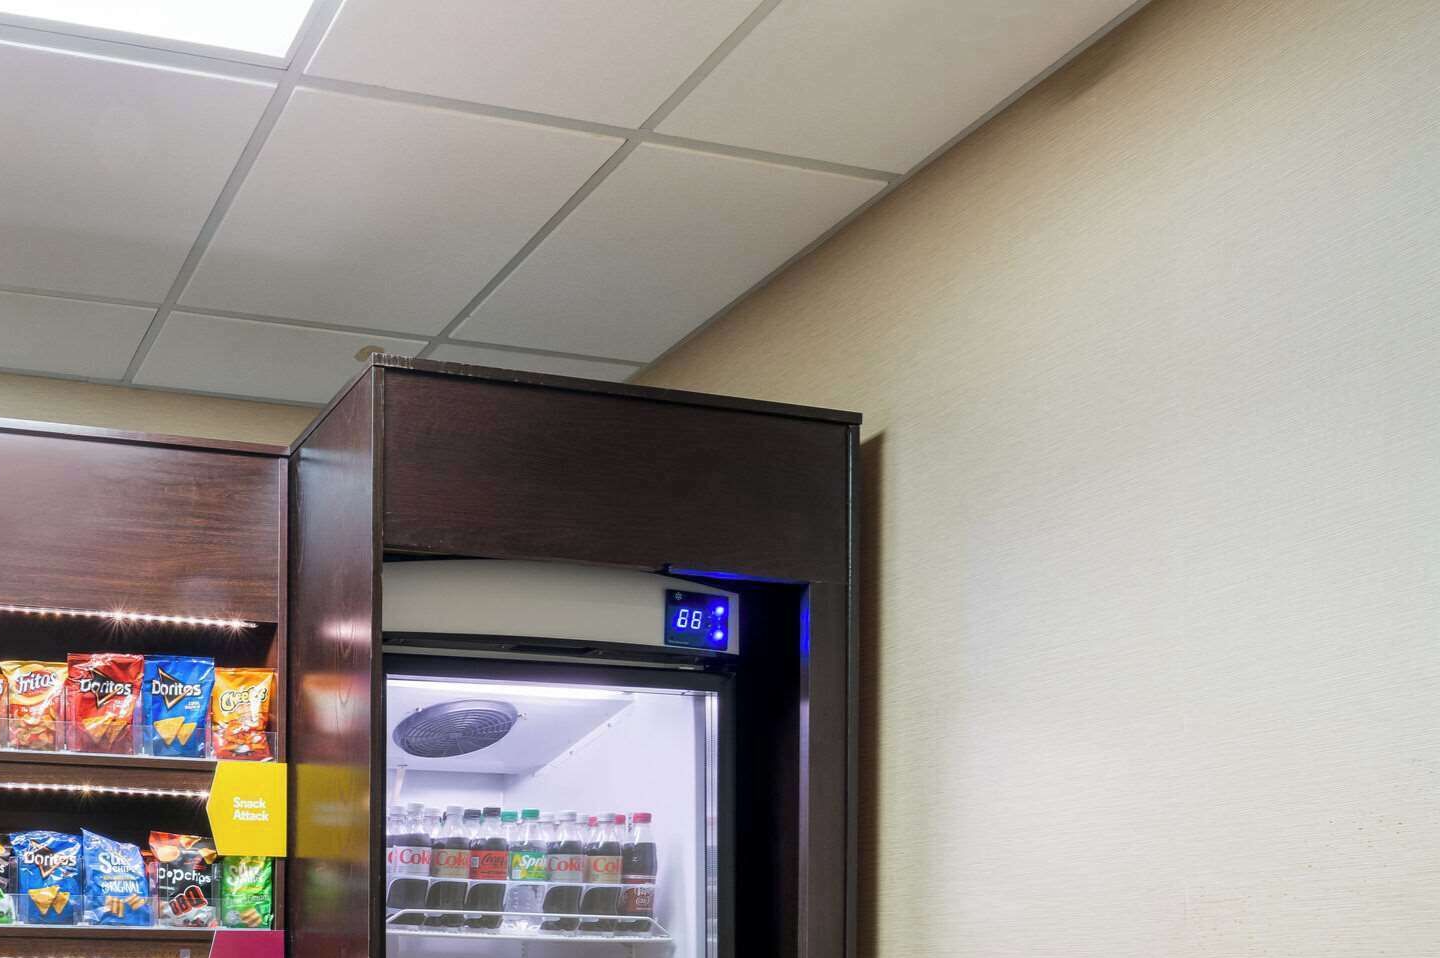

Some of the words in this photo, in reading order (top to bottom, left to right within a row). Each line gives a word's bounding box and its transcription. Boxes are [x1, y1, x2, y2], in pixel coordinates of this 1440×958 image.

[15, 671, 57, 694] Fritos
[79, 678, 133, 697] Doritos
[151, 679, 202, 697] Doritos
[233, 797, 266, 809] Snack
[232, 809, 269, 821] Attack
[23, 852, 78, 867] Doritos
